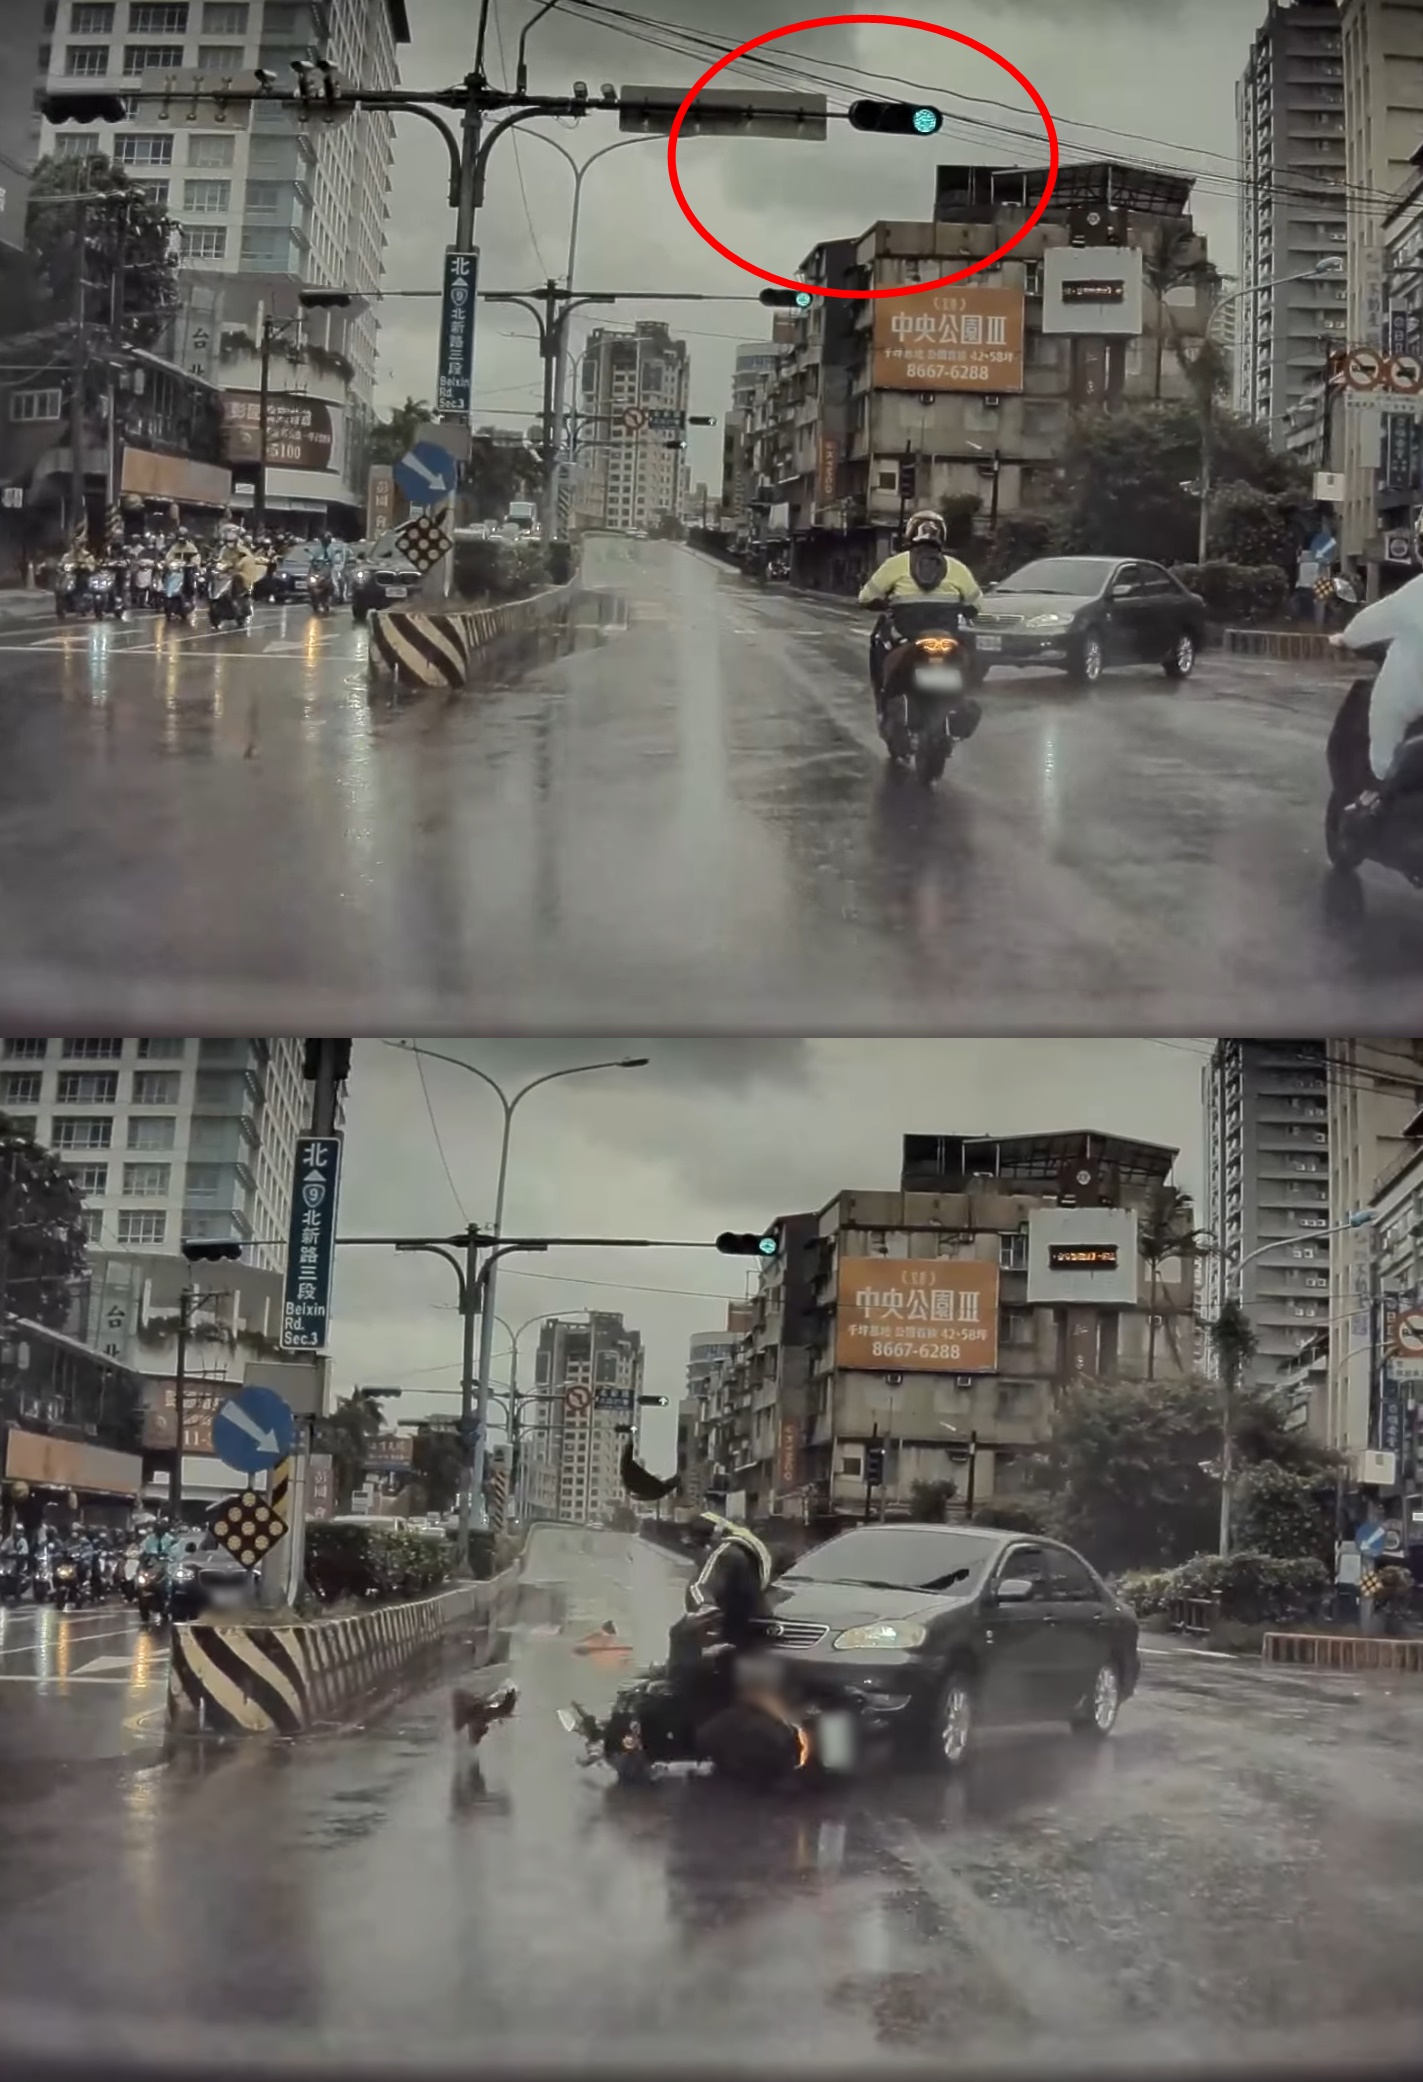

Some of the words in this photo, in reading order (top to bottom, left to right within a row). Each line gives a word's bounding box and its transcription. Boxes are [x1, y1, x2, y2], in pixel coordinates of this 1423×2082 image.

[450, 257, 471, 276] 北
[448, 308, 467, 375] 北新路三段
[906, 363, 989, 381] 8667-6288
[440, 375, 470, 388] Beixin
[303, 1142, 328, 1167] 北
[297, 1210, 321, 1300] 北新路三段
[286, 1301, 325, 1316] Beixin
[284, 1317, 304, 1330] Rd.
[283, 1331, 318, 1345] Sec.3
[872, 1341, 961, 1359] 8667-6288
